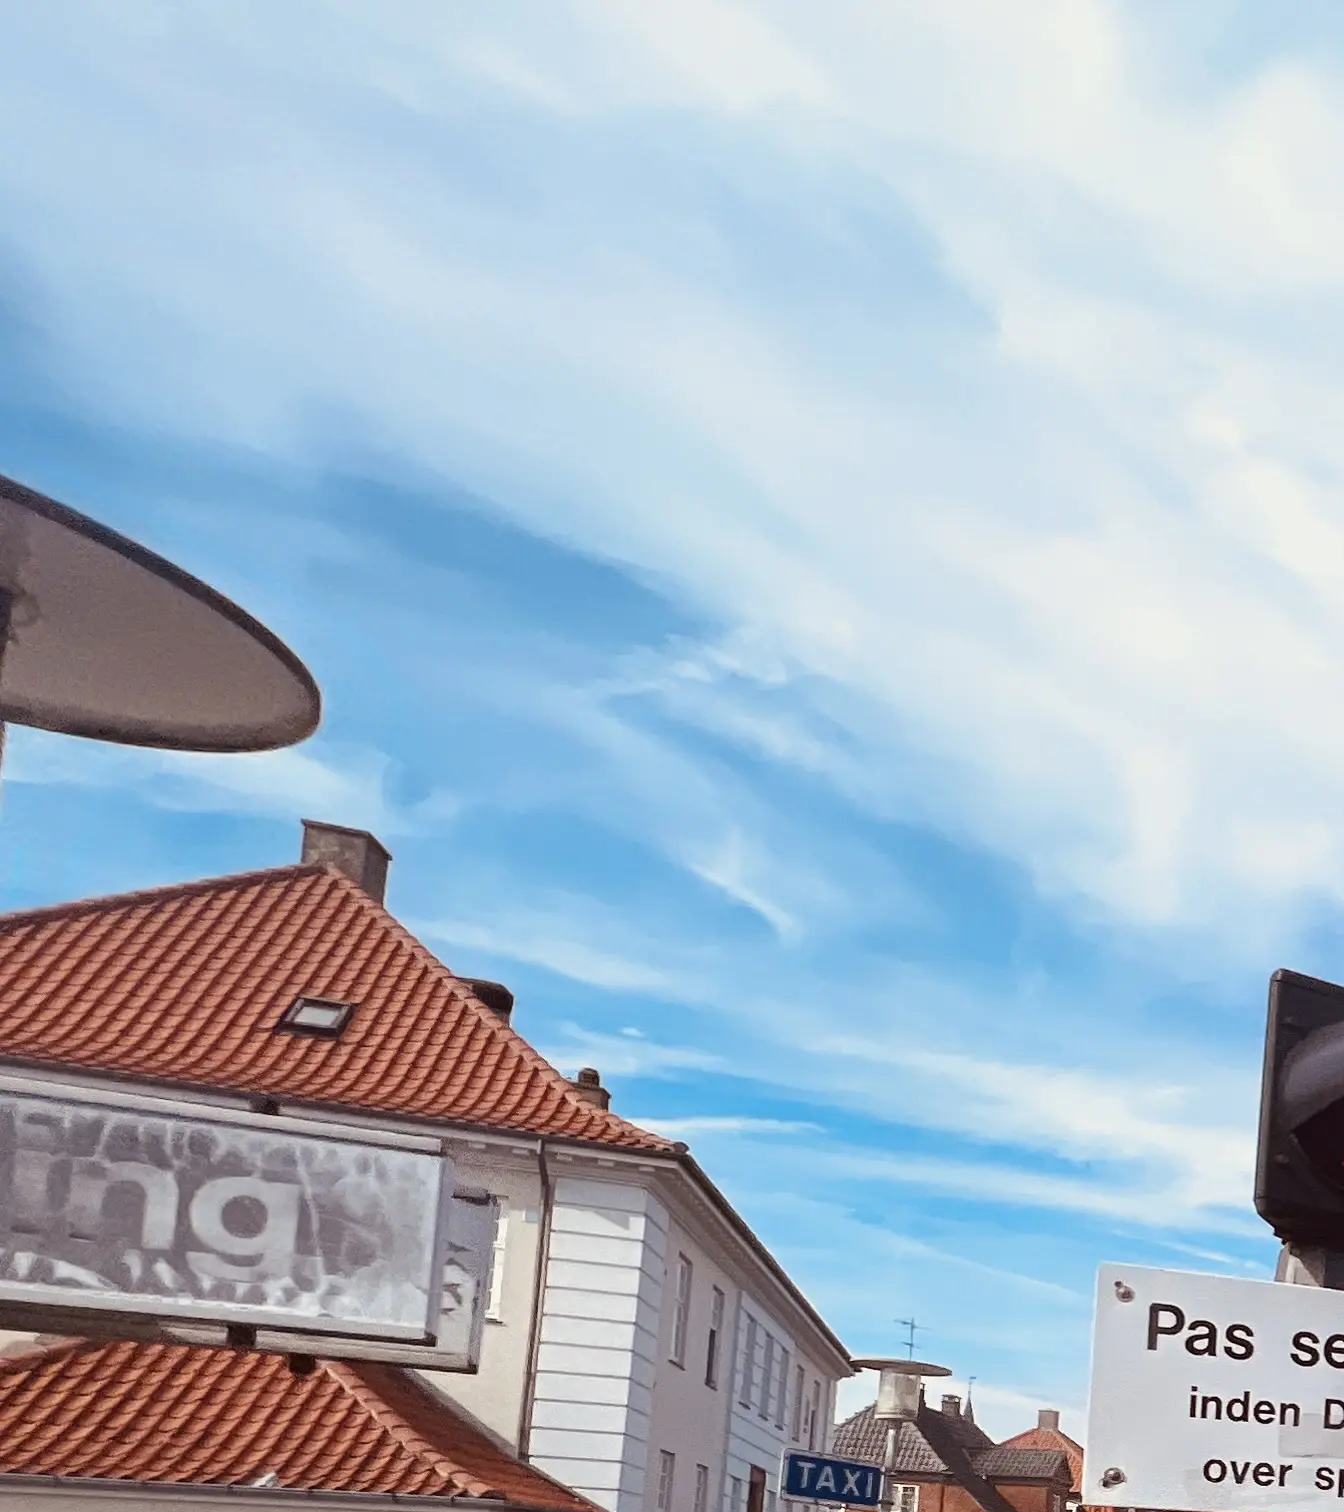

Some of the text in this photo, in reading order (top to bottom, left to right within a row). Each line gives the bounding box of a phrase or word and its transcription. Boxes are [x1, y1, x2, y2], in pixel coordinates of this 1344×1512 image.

[1146, 1303, 1254, 1361] Pas
[1189, 1386, 1300, 1427] inden
[796, 1461, 874, 1498] TAXI
[1203, 1458, 1293, 1488] over
